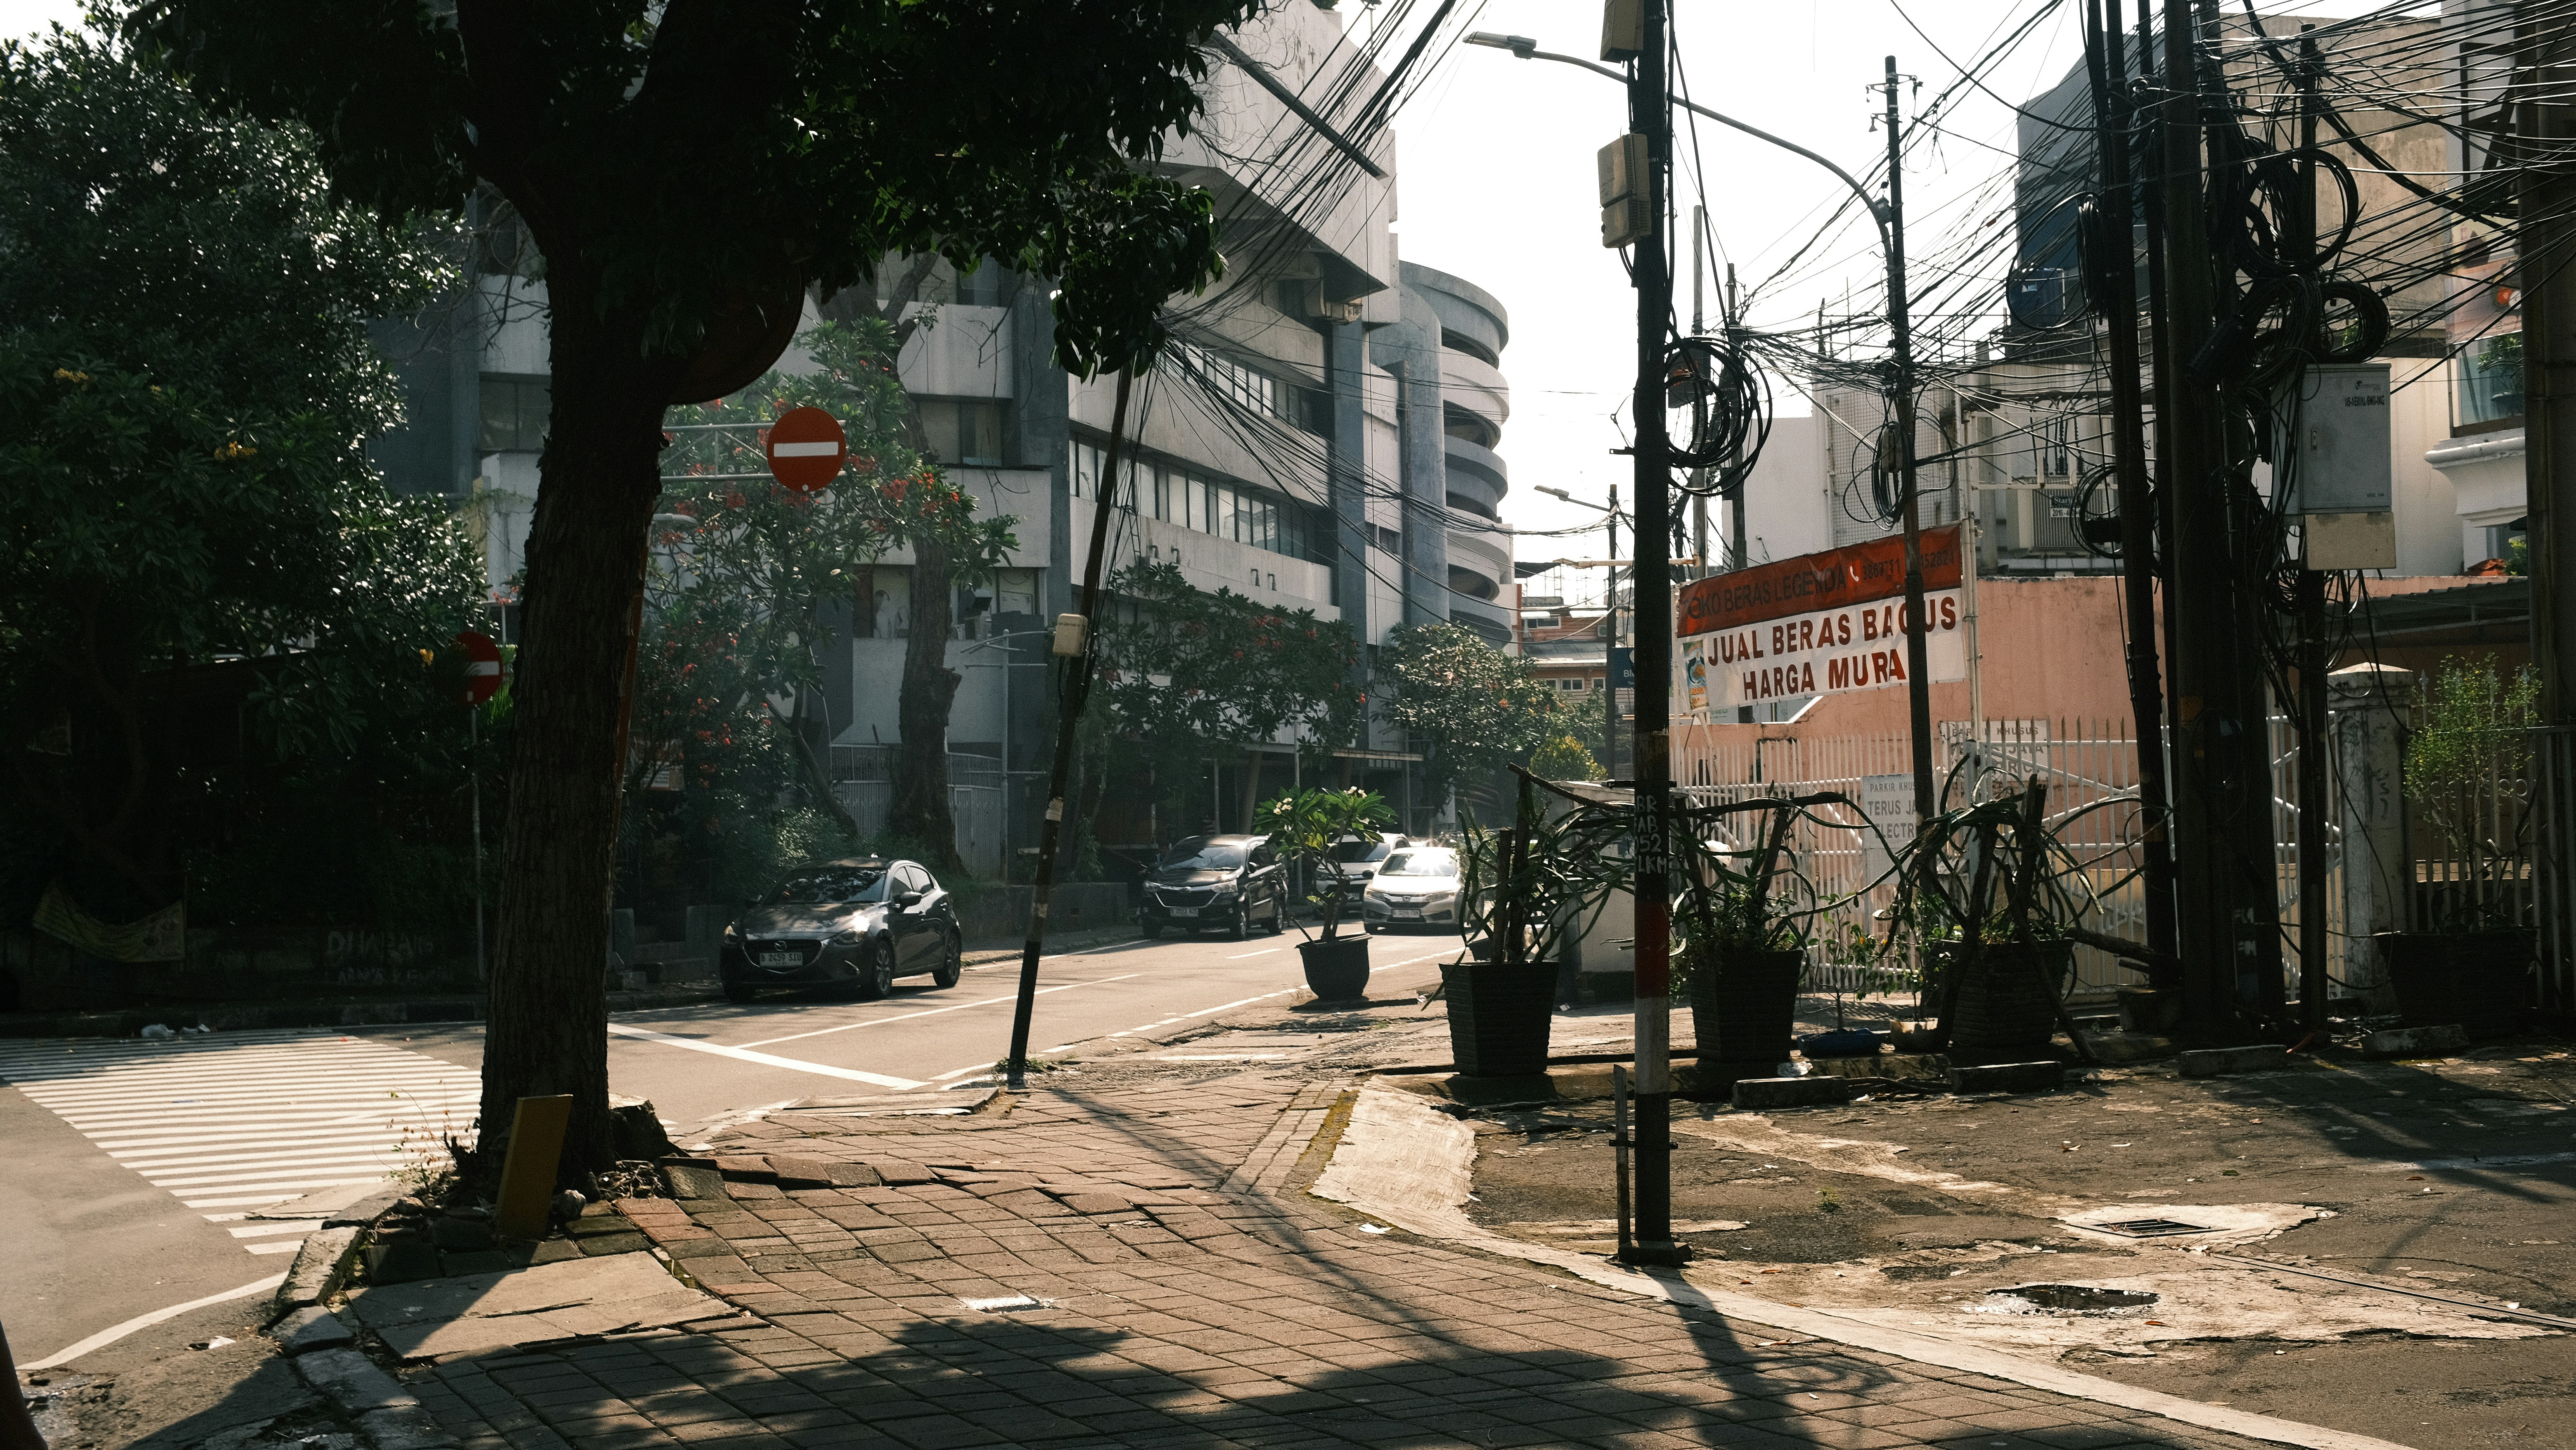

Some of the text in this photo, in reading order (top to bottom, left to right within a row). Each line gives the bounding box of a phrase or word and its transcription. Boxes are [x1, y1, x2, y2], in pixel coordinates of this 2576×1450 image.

[1724, 583, 1771, 612] BERAS
[1775, 564, 1847, 602] LEGENDA
[1708, 630, 1764, 666] JUAL
[1773, 613, 1851, 656] BERAS
[1743, 648, 1906, 700] HARGA MURA
[1870, 782, 1915, 792] PARKIR KHU
[1868, 799, 1916, 816] TERUS JA
[1634, 814, 1659, 834] AB
[1875, 822, 1916, 839] ELECTR
[1635, 855, 1667, 875] LKM
[761, 954, 765, 962] B
